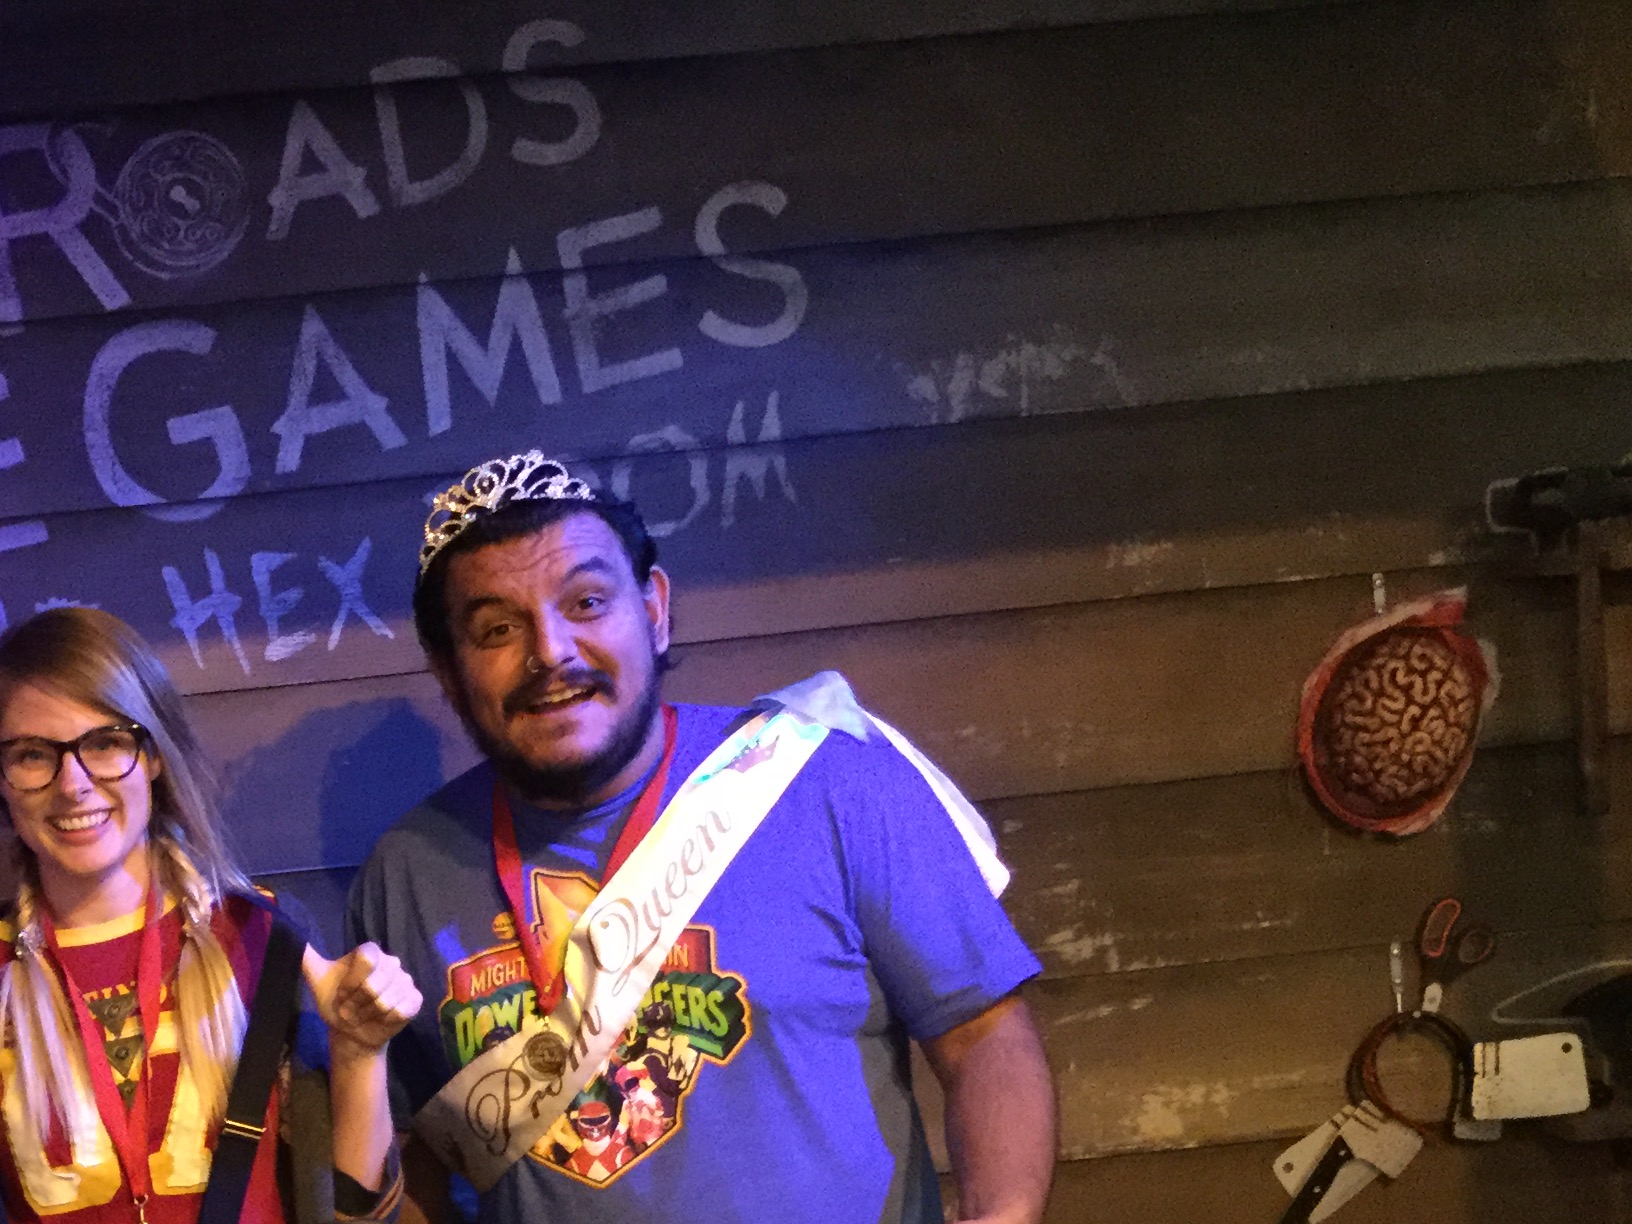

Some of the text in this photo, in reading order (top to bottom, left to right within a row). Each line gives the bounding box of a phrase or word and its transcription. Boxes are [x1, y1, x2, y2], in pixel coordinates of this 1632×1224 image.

[82, 180, 808, 522] GAMES
[162, 535, 395, 676] HEX
[587, 809, 731, 997] Queen
[455, 989, 540, 1070] POWE
[470, 956, 528, 997] MIGHT
